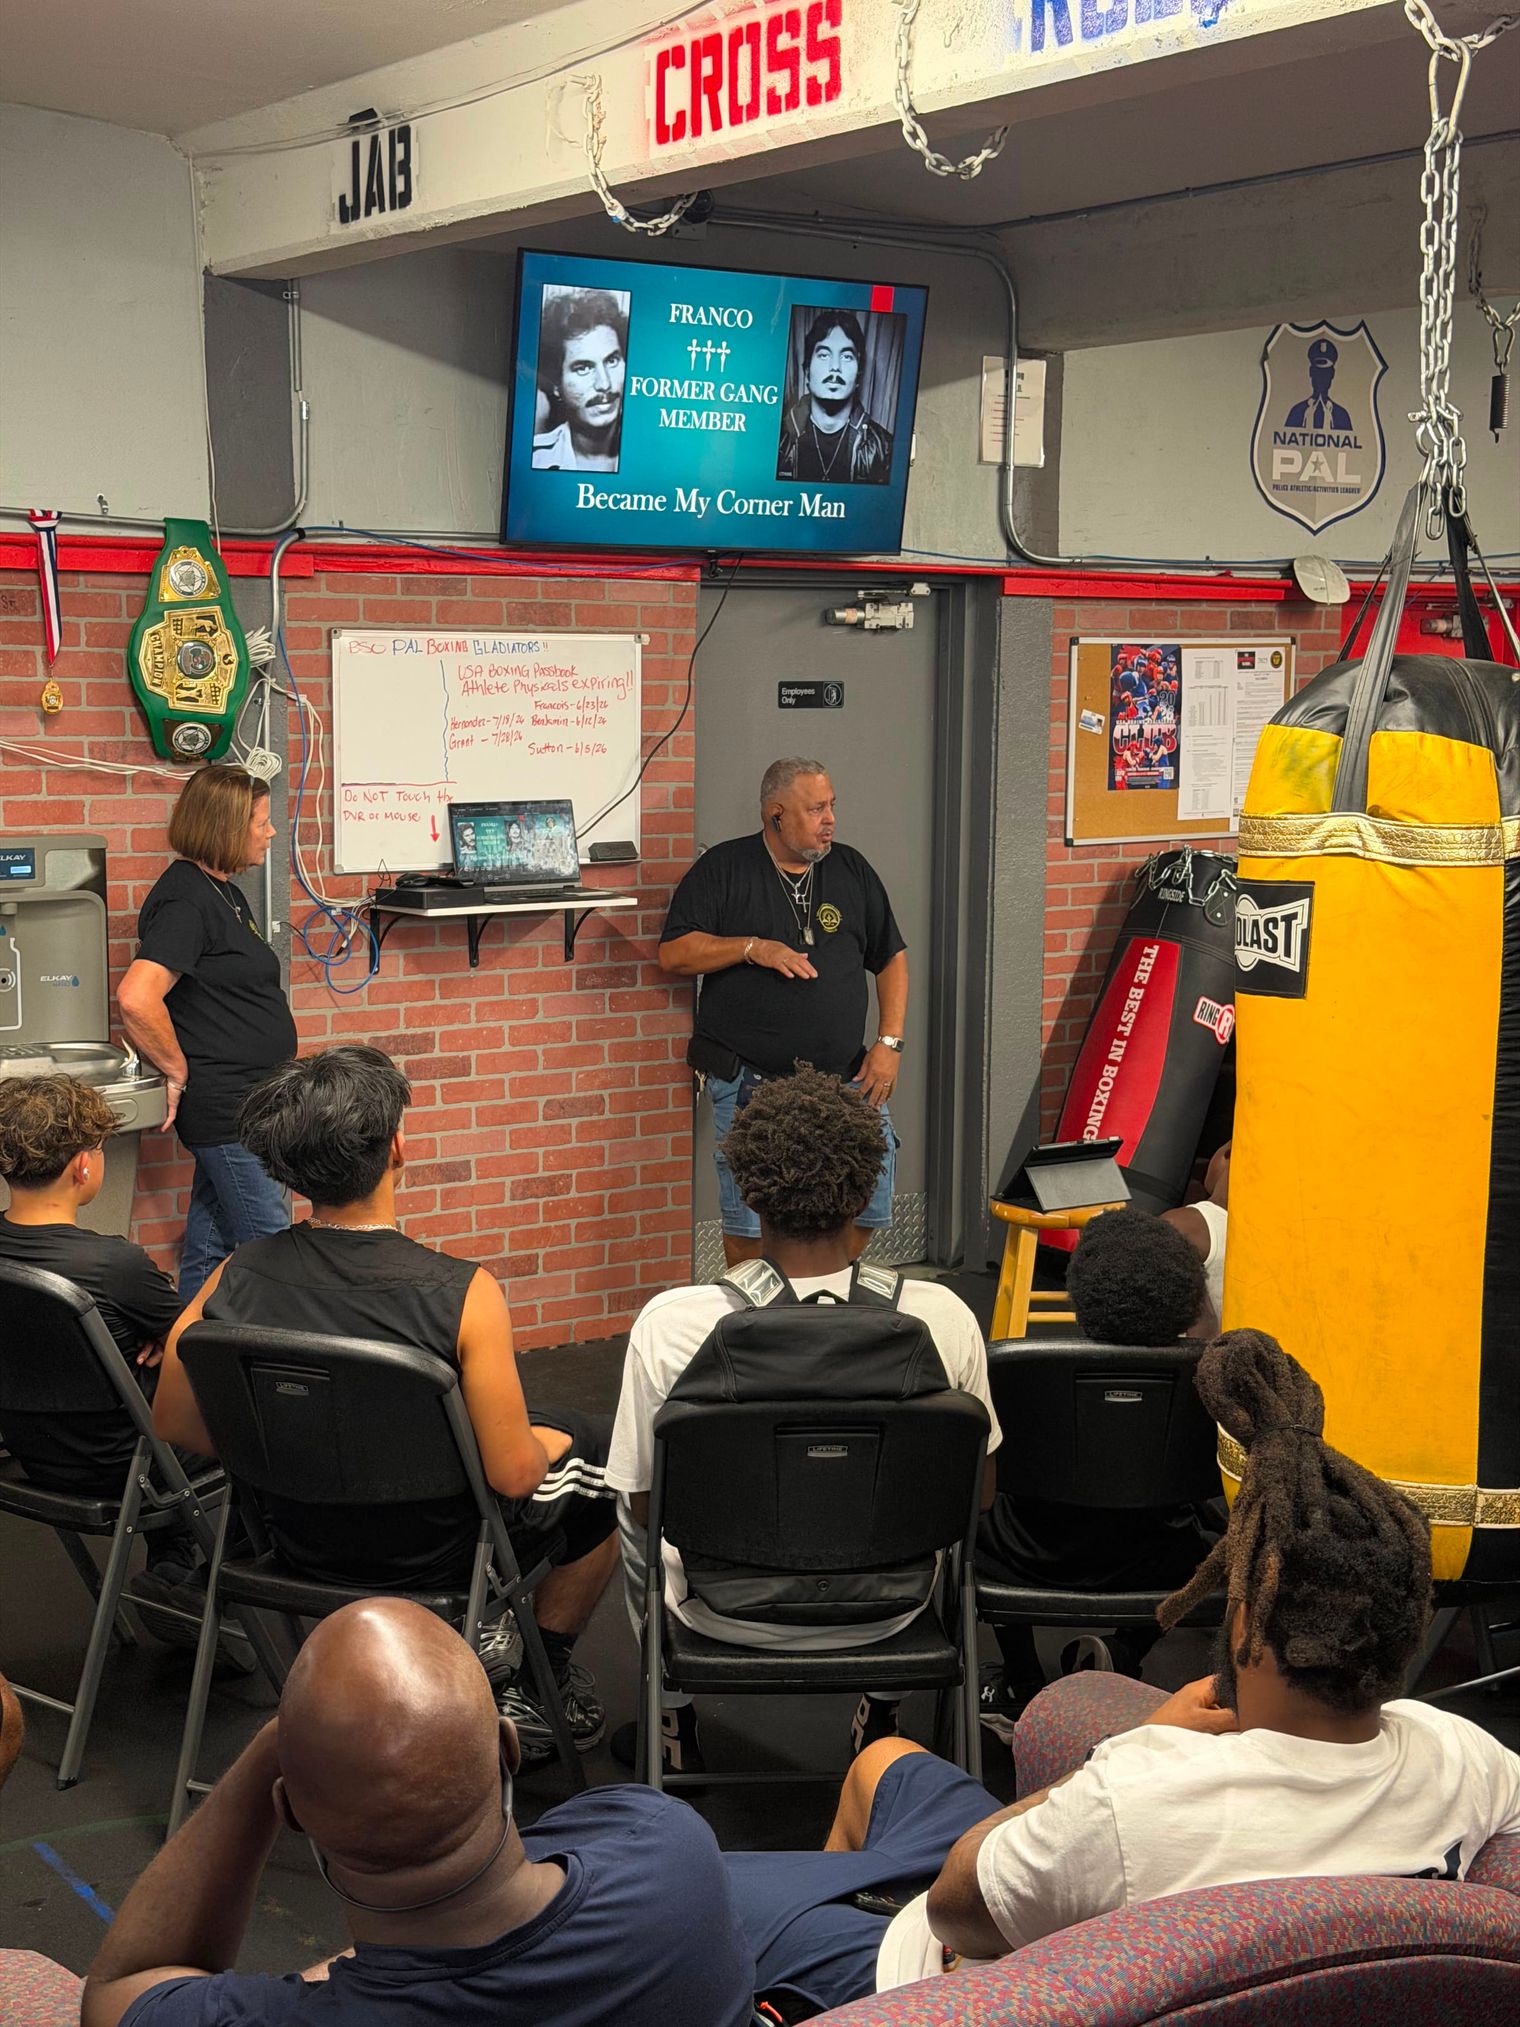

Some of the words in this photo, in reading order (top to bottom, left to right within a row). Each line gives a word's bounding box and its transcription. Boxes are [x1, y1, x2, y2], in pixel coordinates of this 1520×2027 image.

[656, 0, 843, 145] CROSS
[338, 124, 413, 225] JAB
[669, 303, 753, 330] FRANCO
[630, 376, 714, 402] FORMER
[719, 382, 779, 406] GANG
[659, 408, 747, 433] MEMBER
[1273, 431, 1362, 449] NATIONAL
[1272, 449, 1361, 483] PAL
[576, 483, 667, 513] Became
[673, 488, 709, 519] My
[716, 490, 794, 517] Corner
[799, 493, 846, 519] Man
[392, 638, 423, 655] PAL
[150, 632, 164, 688] CHAMPION
[458, 664, 483, 681] USA
[461, 679, 510, 697] Athlete
[781, 688, 815, 696] Employees
[781, 697, 796, 705] Only
[1160, 691, 1175, 706] 20
[1112, 724, 1177, 755] CLUB
[363, 791, 388, 803] NOT
[1133, 944, 1160, 984] THE
[1117, 986, 1145, 1037] BEST
[1197, 1001, 1221, 1026] RING
[1107, 1038, 1127, 1063] IN
[1083, 1064, 1119, 1144] BOXING
